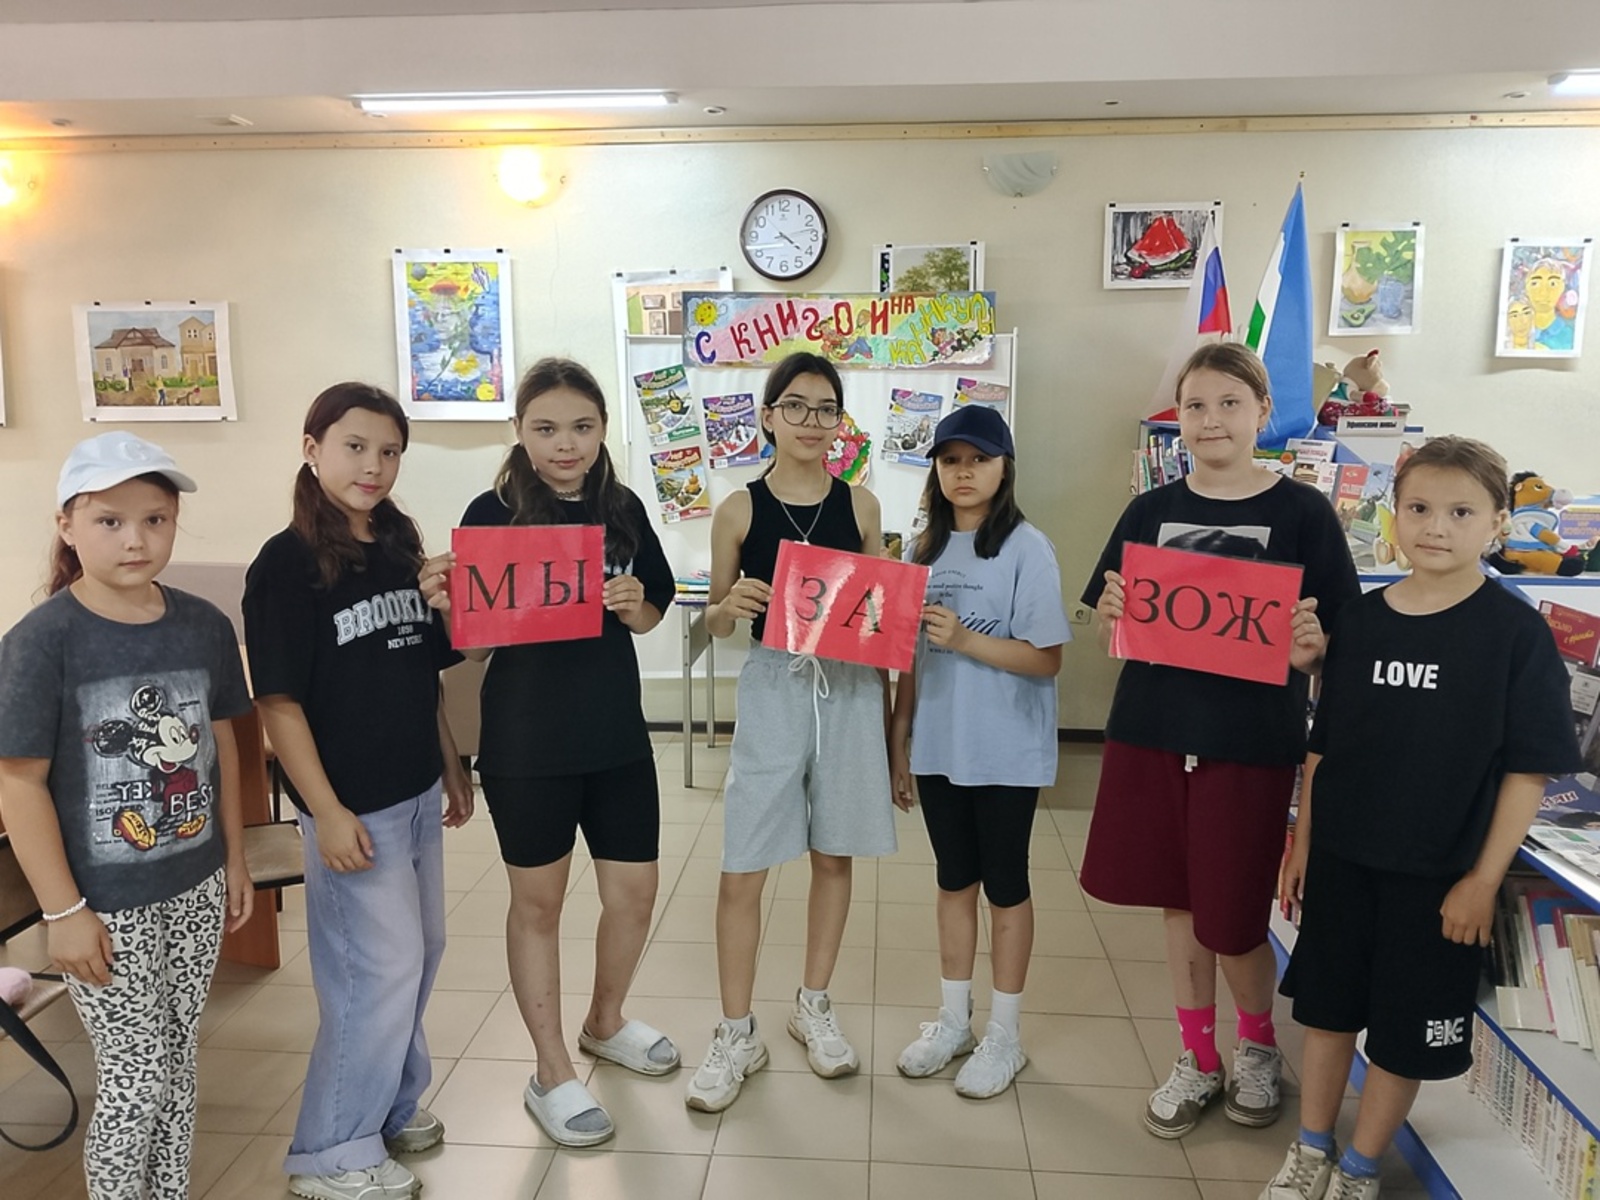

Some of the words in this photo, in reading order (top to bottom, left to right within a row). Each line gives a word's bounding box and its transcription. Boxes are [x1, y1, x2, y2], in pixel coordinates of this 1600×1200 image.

[764, 203, 775, 216] 11
[778, 199, 790, 213] 12
[796, 203, 801, 216] 1
[754, 215, 766, 229] 10
[804, 214, 814, 227] 2
[749, 230, 759, 242] 9
[809, 229, 819, 242] 3
[804, 245, 814, 257] 4
[766, 255, 774, 268] 7
[779, 260, 789, 273] 6
[794, 255, 804, 268] 5
[890, 295, 916, 315] НА
[464, 559, 590, 613] МЫ
[793, 574, 884, 635] ЗА
[1127, 577, 1281, 647] ЗОЖ
[387, 638, 405, 649] NEW
[1372, 660, 1439, 689] LOVE
